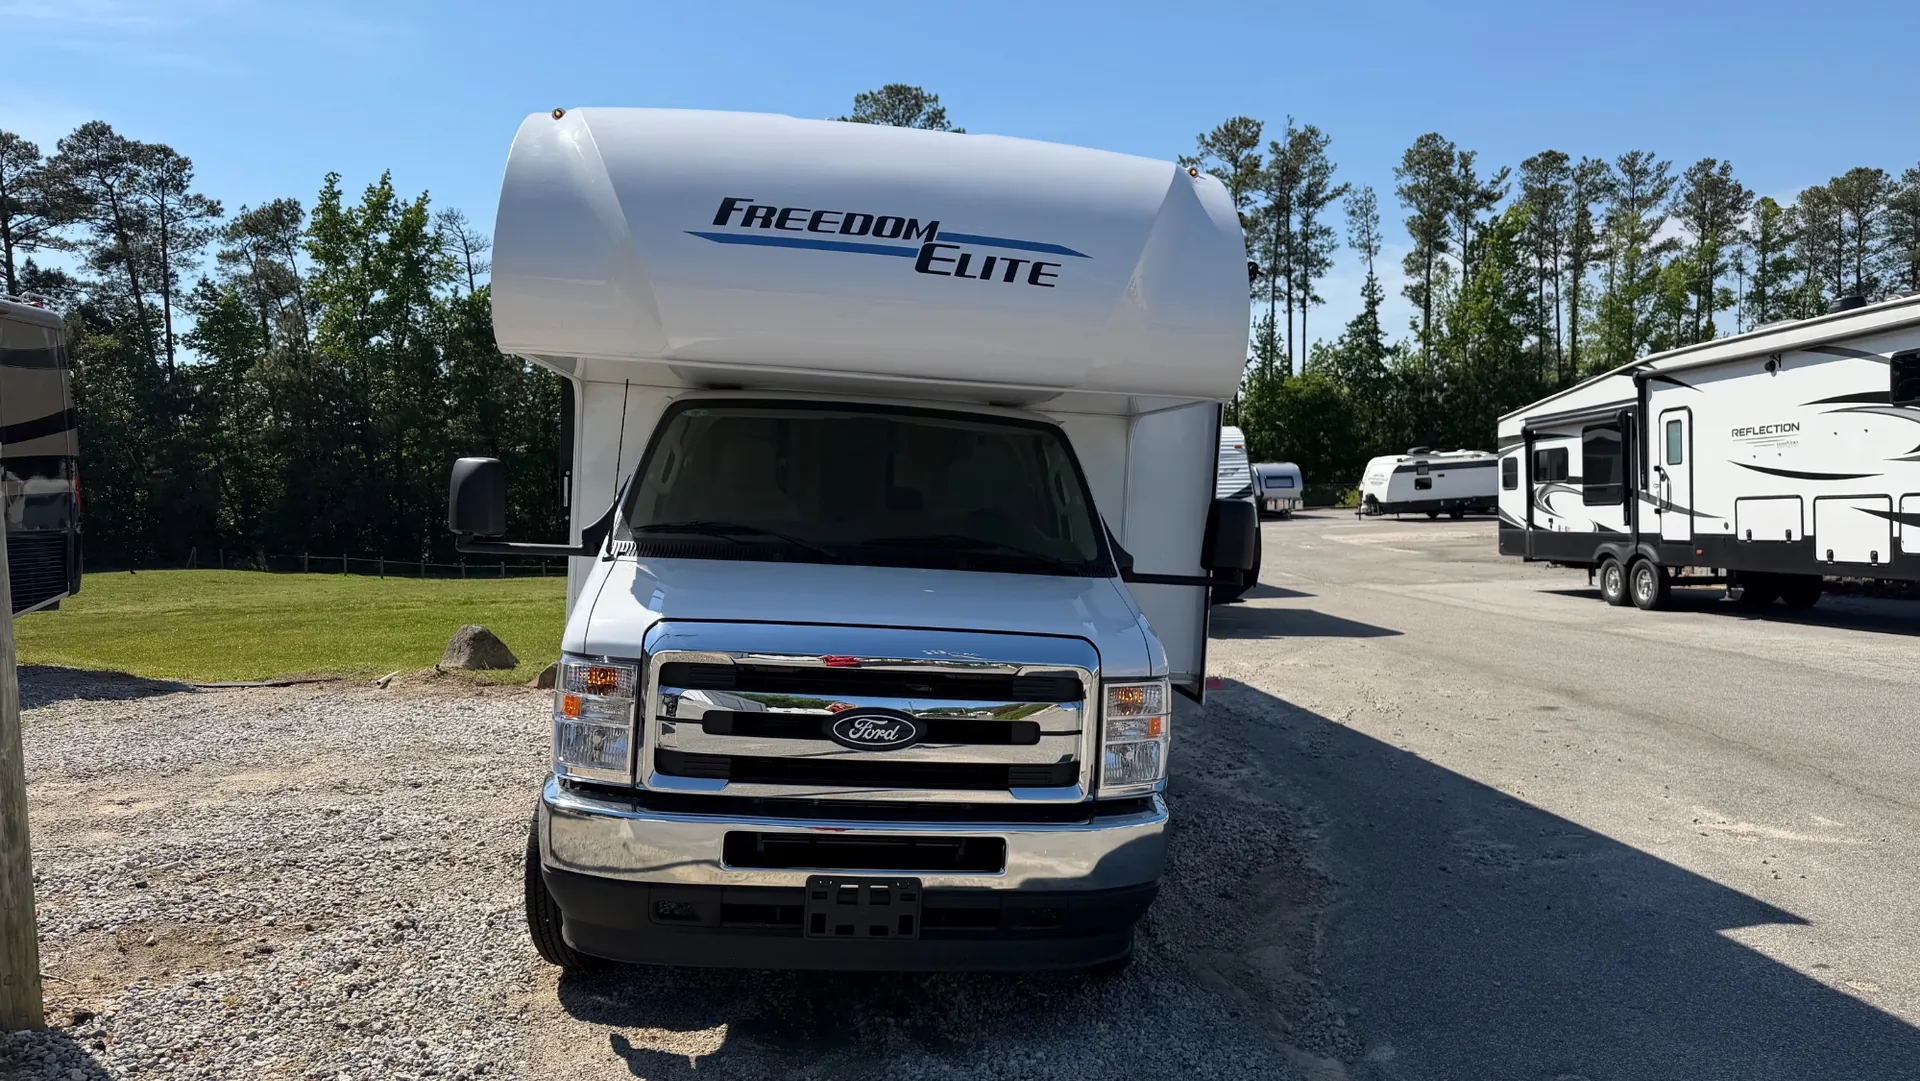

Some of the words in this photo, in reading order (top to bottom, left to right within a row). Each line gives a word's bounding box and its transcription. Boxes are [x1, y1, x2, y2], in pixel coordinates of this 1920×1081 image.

[712, 197, 940, 243] FREEDOM
[914, 243, 1062, 288] ELITE
[1731, 421, 1800, 437] REFLECTION
[849, 718, 900, 740] Ford
